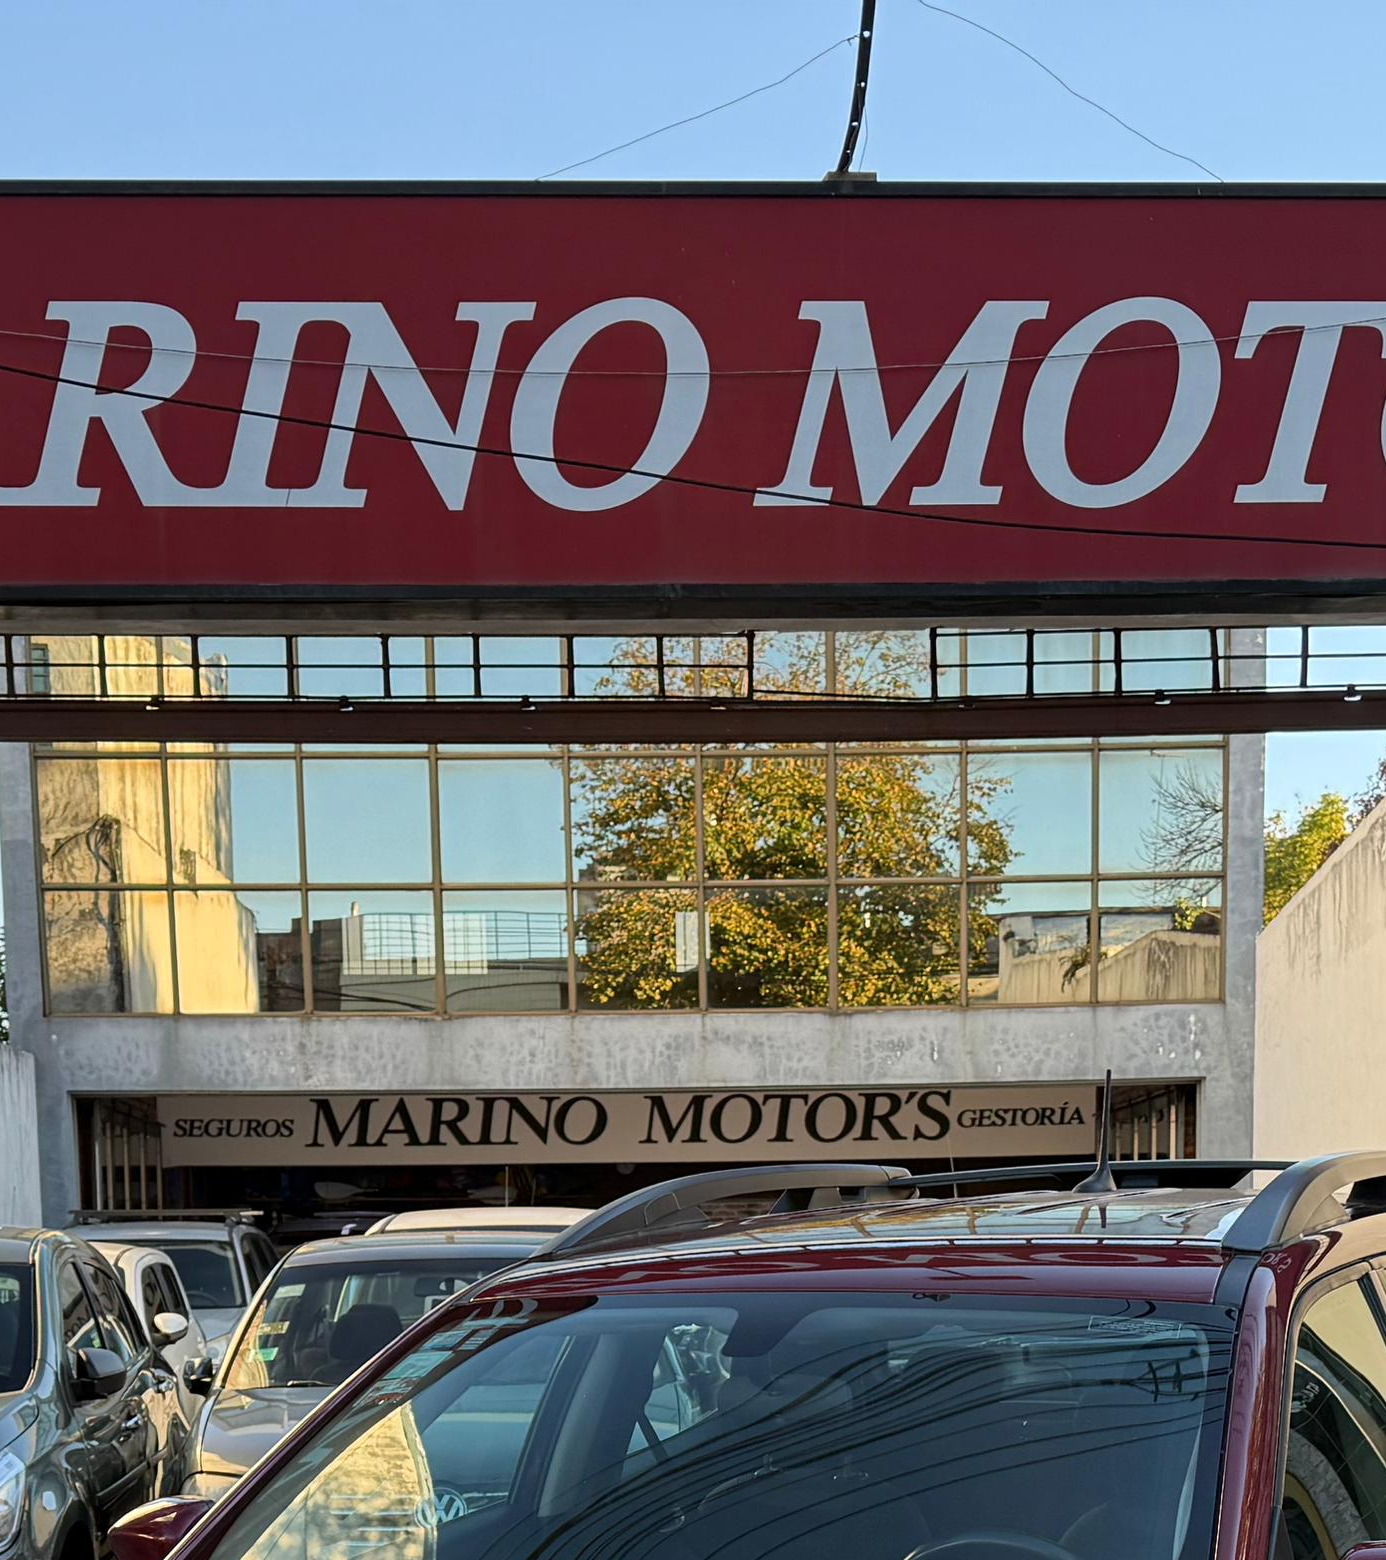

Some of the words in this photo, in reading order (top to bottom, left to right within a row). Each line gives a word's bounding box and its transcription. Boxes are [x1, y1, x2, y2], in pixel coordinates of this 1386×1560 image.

[173, 1118, 294, 1138] SEGUROS
[305, 1096, 609, 1148] MARINO
[638, 1090, 951, 1143] MOTOR'S
[957, 1101, 1084, 1129] GESTORÍA
